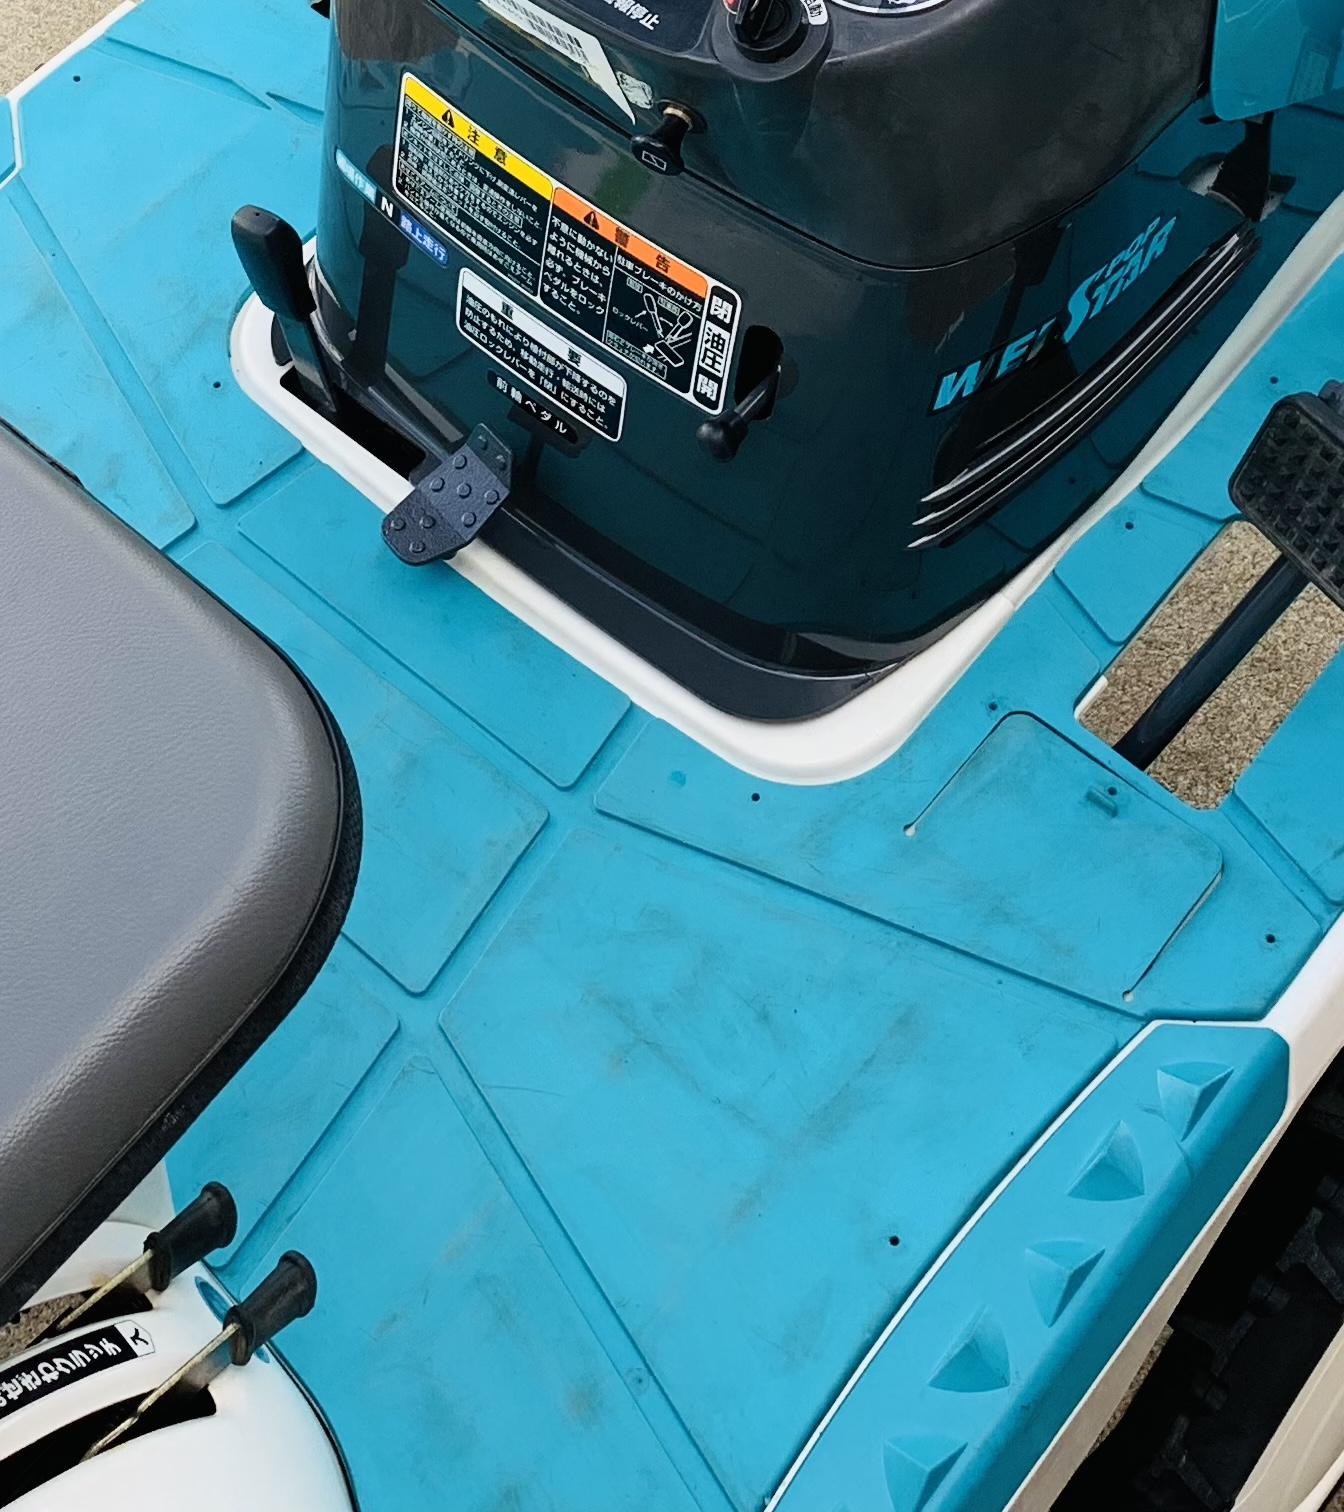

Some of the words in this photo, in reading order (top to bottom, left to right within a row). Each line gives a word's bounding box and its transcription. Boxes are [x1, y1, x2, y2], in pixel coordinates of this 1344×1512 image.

[466, 124, 508, 168] 注意
[380, 194, 393, 219] N
[551, 215, 614, 264] 不意に動かない
[543, 269, 604, 318] ペダルをロック
[616, 253, 702, 314] 駐車ブレーキのかけ方
[708, 293, 733, 325] 閉
[700, 326, 727, 375] 油圧
[695, 372, 719, 403] 開
